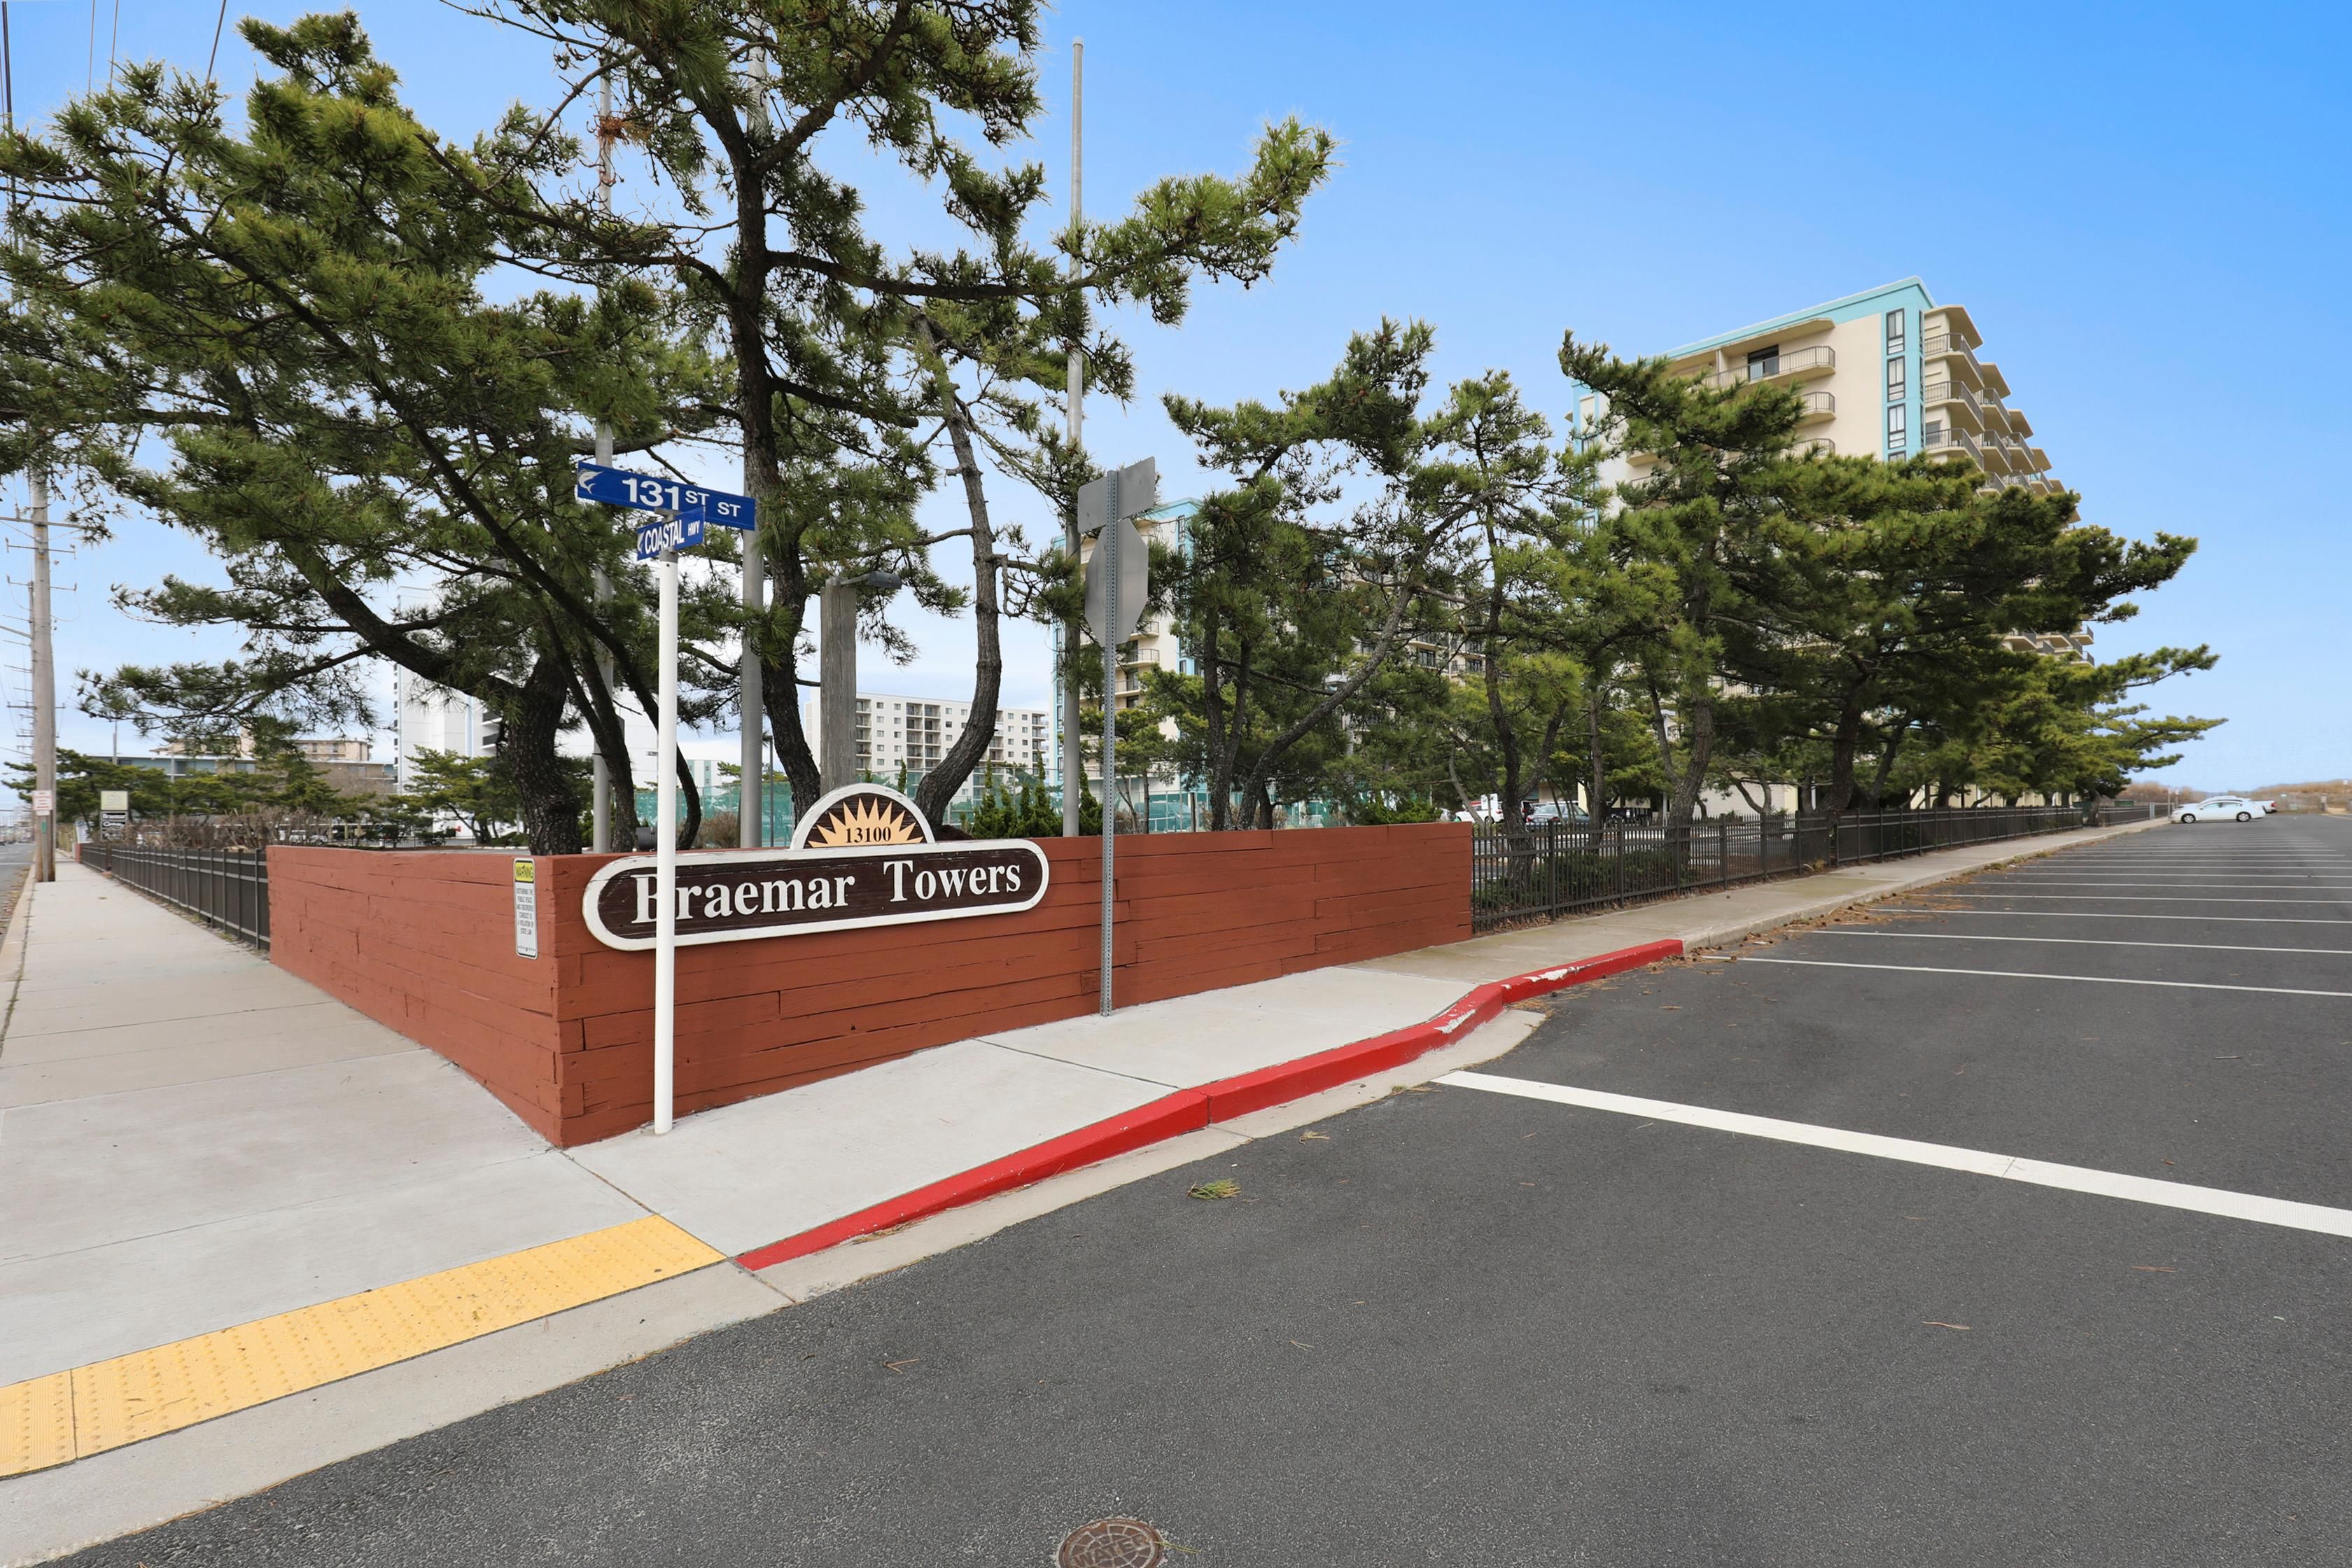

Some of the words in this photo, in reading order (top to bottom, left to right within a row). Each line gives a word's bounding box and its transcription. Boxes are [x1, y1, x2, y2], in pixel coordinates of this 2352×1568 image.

[717, 502, 741, 517] ST
[644, 519, 685, 554] COASTAL
[687, 520, 701, 536] HWY
[845, 826, 891, 844] 13100
[630, 873, 855, 924] Braemar
[883, 860, 1022, 902] Towers
